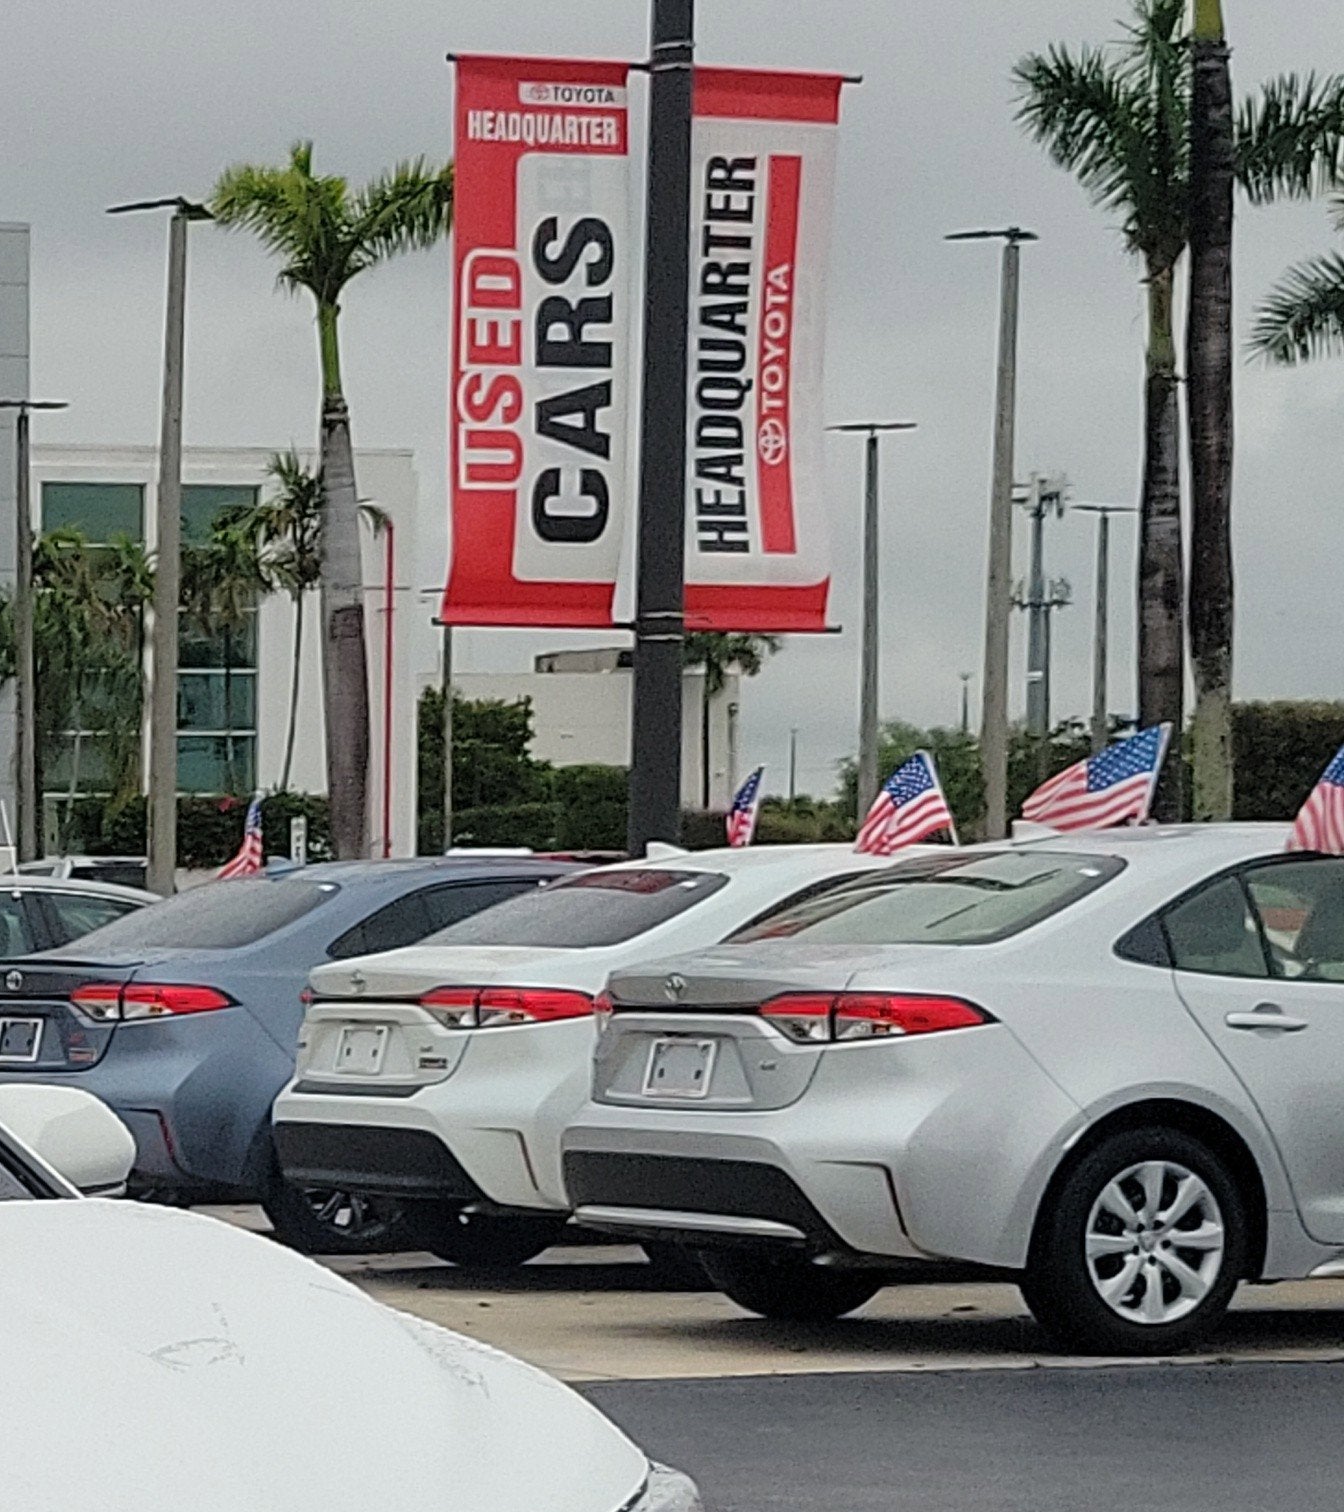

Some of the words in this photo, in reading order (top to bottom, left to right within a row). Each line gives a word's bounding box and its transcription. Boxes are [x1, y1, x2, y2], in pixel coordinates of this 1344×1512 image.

[468, 110, 618, 146] HEADQUARTER
[553, 86, 615, 102] TOYOTA
[457, 247, 524, 490] USED
[531, 216, 613, 543] CARS
[695, 155, 757, 553] HEADQUARTER
[762, 262, 789, 415] TOYOTA
